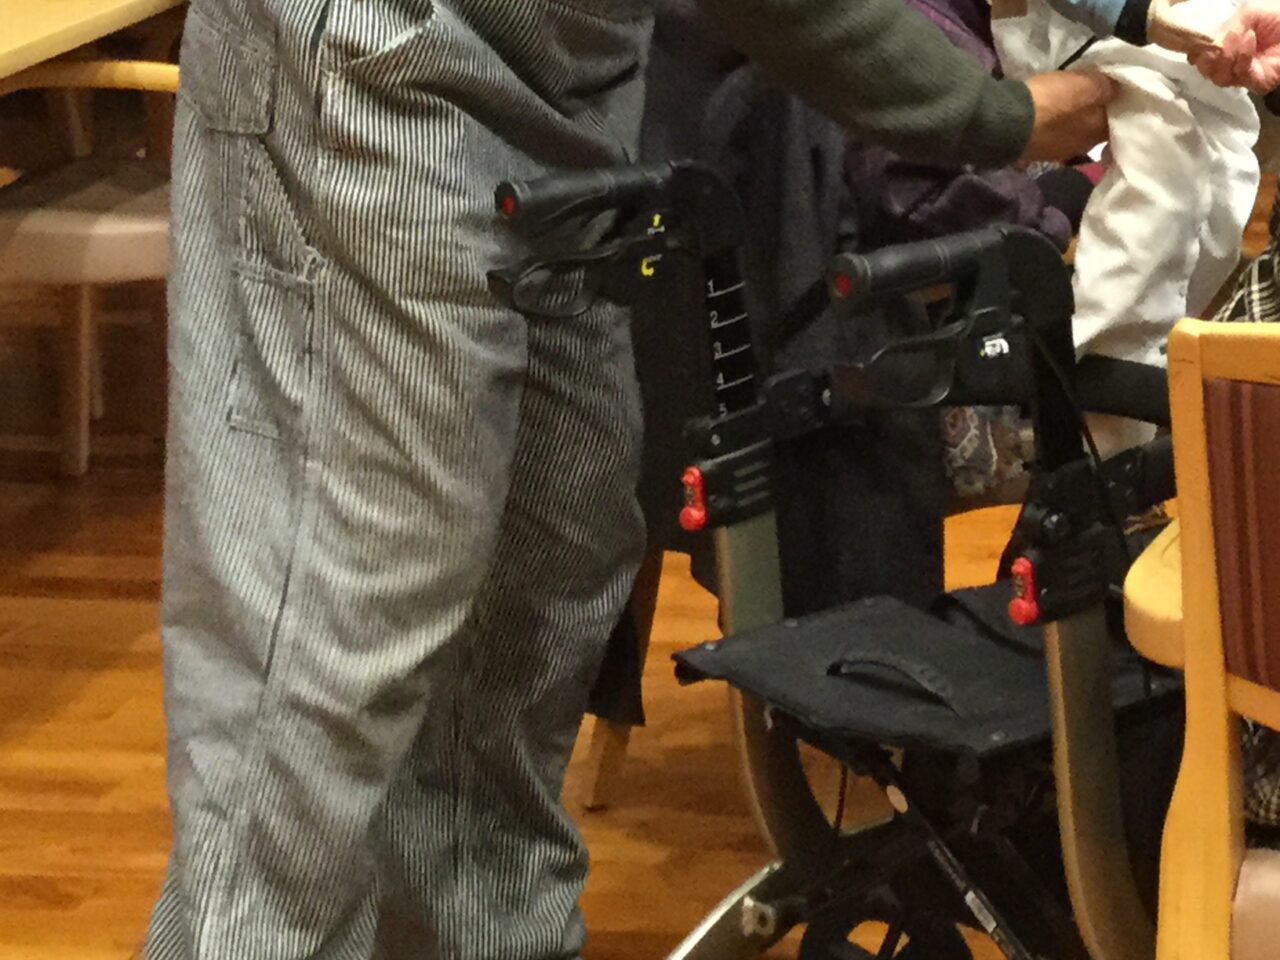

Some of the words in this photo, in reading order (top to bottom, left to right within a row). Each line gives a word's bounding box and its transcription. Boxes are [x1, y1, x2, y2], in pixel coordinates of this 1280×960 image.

[707, 279, 714, 294] 1
[710, 310, 719, 326] 2
[713, 341, 722, 357] 3
[716, 372, 724, 385] 4
[719, 403, 728, 417] 5
